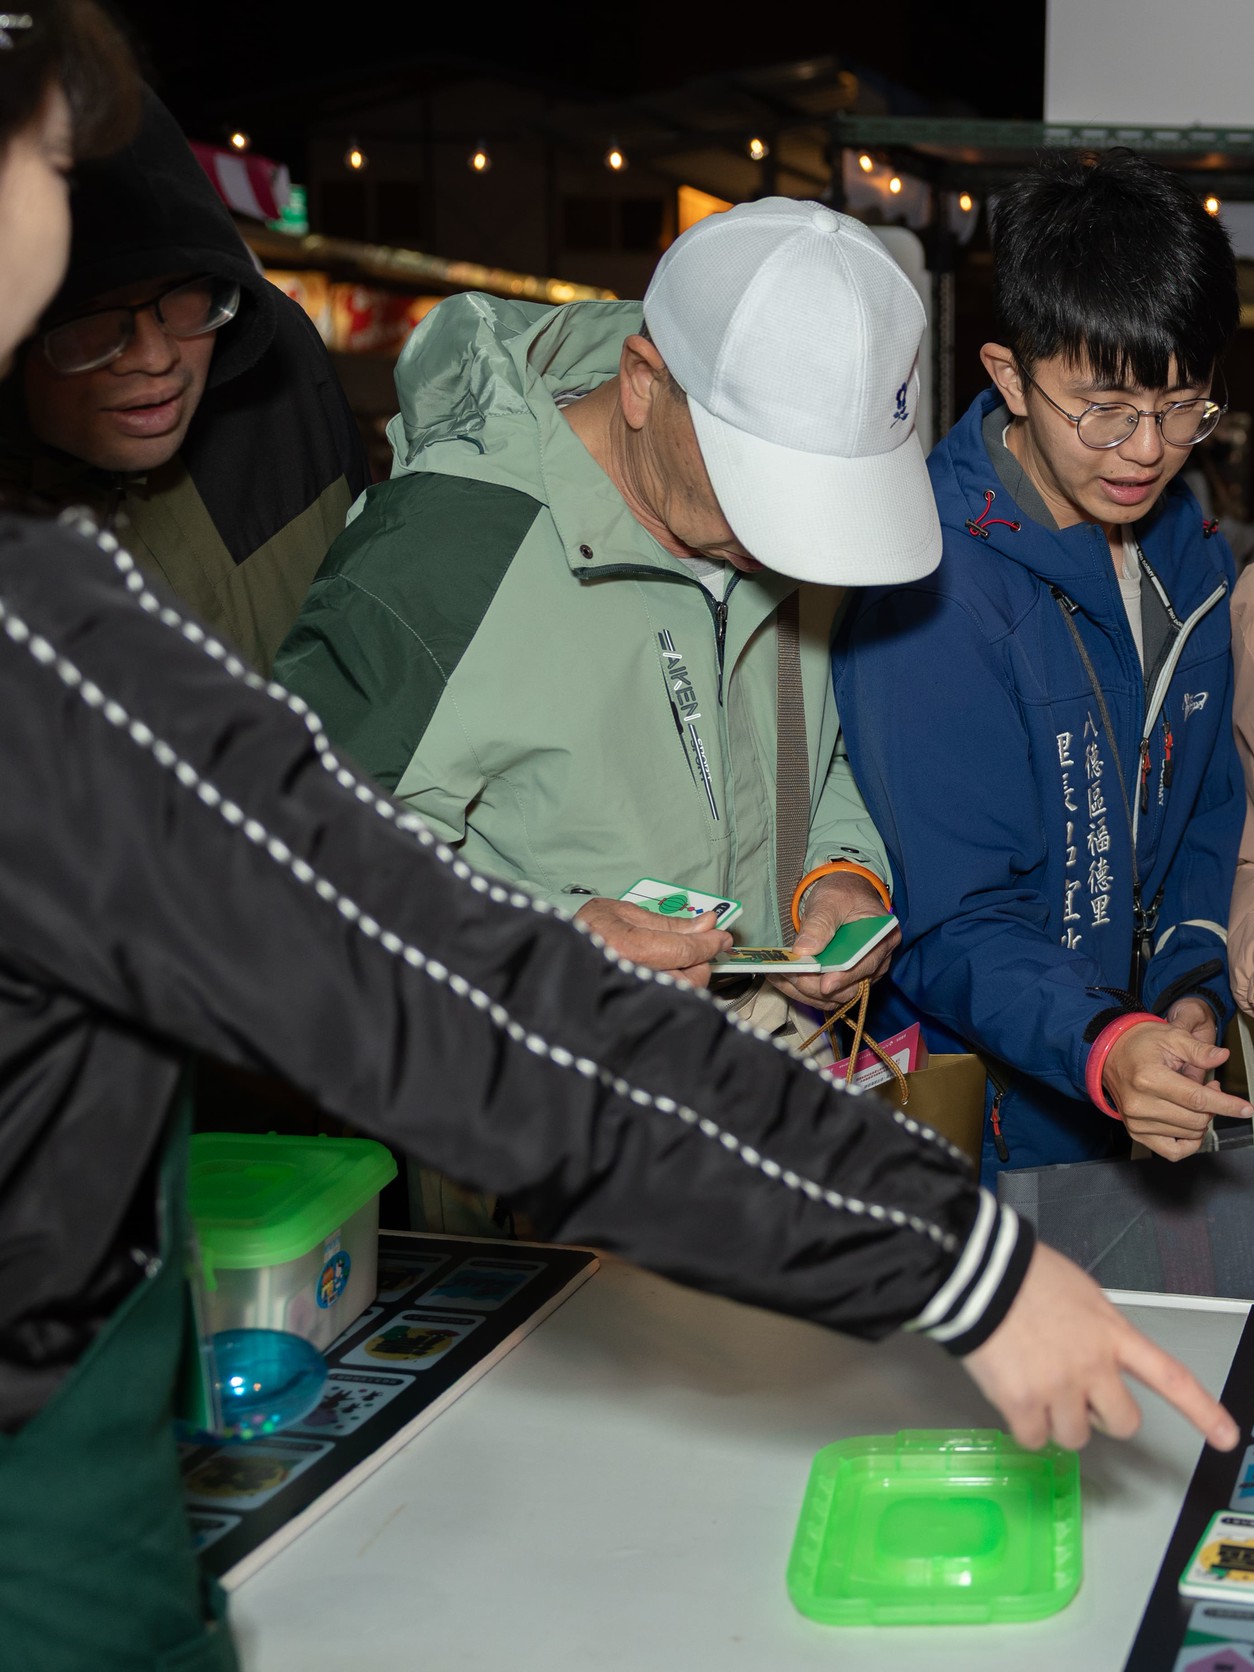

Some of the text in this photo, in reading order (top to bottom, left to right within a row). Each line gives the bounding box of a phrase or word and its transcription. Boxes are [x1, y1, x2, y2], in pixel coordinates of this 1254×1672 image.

[1083, 710, 1114, 927] 八德區福德里
